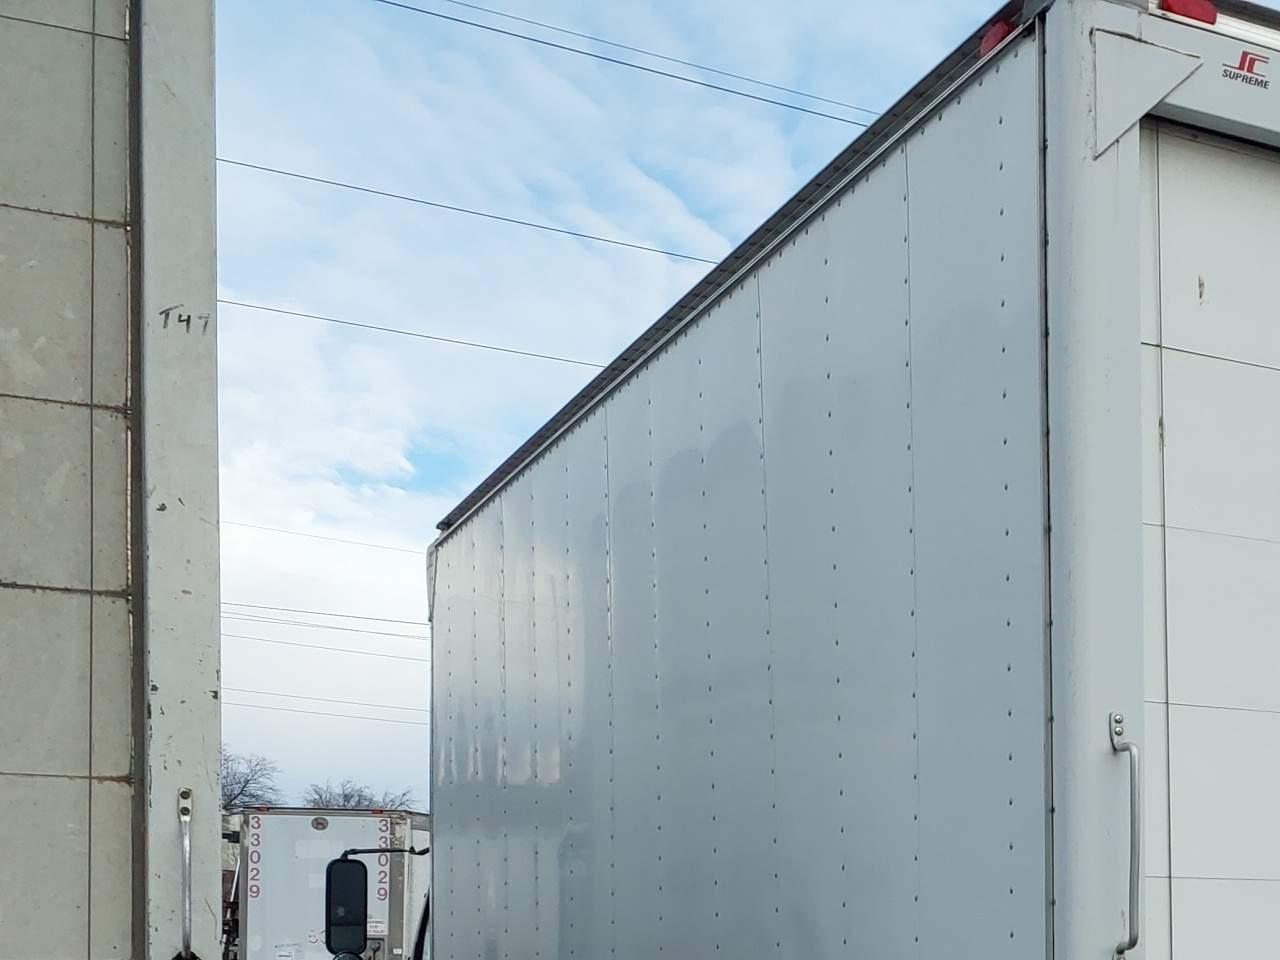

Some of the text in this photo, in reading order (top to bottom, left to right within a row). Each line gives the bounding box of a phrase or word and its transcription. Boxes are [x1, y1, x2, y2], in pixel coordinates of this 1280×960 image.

[1222, 68, 1270, 90] SUPREME
[249, 815, 262, 899] 33029
[377, 818, 390, 901] 33029
